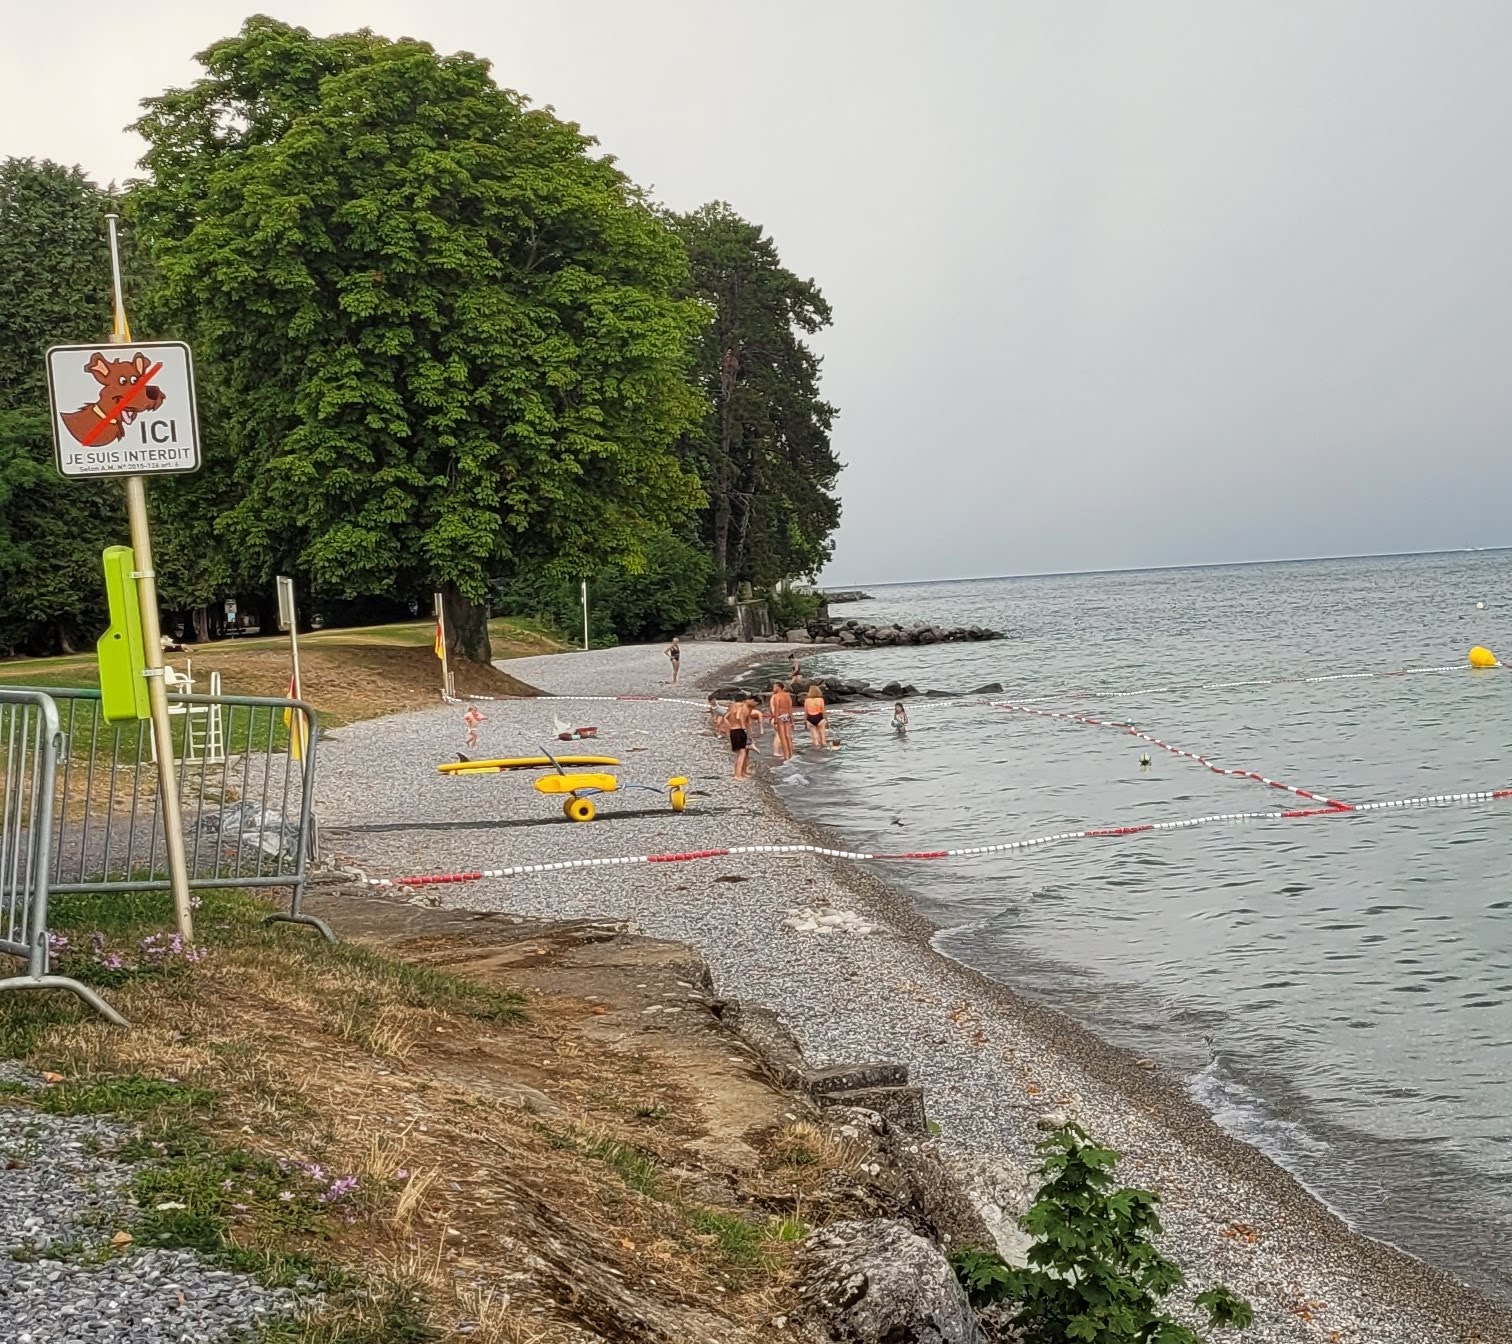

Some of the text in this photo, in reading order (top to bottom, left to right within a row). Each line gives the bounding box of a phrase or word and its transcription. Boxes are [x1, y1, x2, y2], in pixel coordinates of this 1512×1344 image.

[140, 420, 178, 444] ICI
[66, 448, 190, 465] JE SUIS INTERDIT
